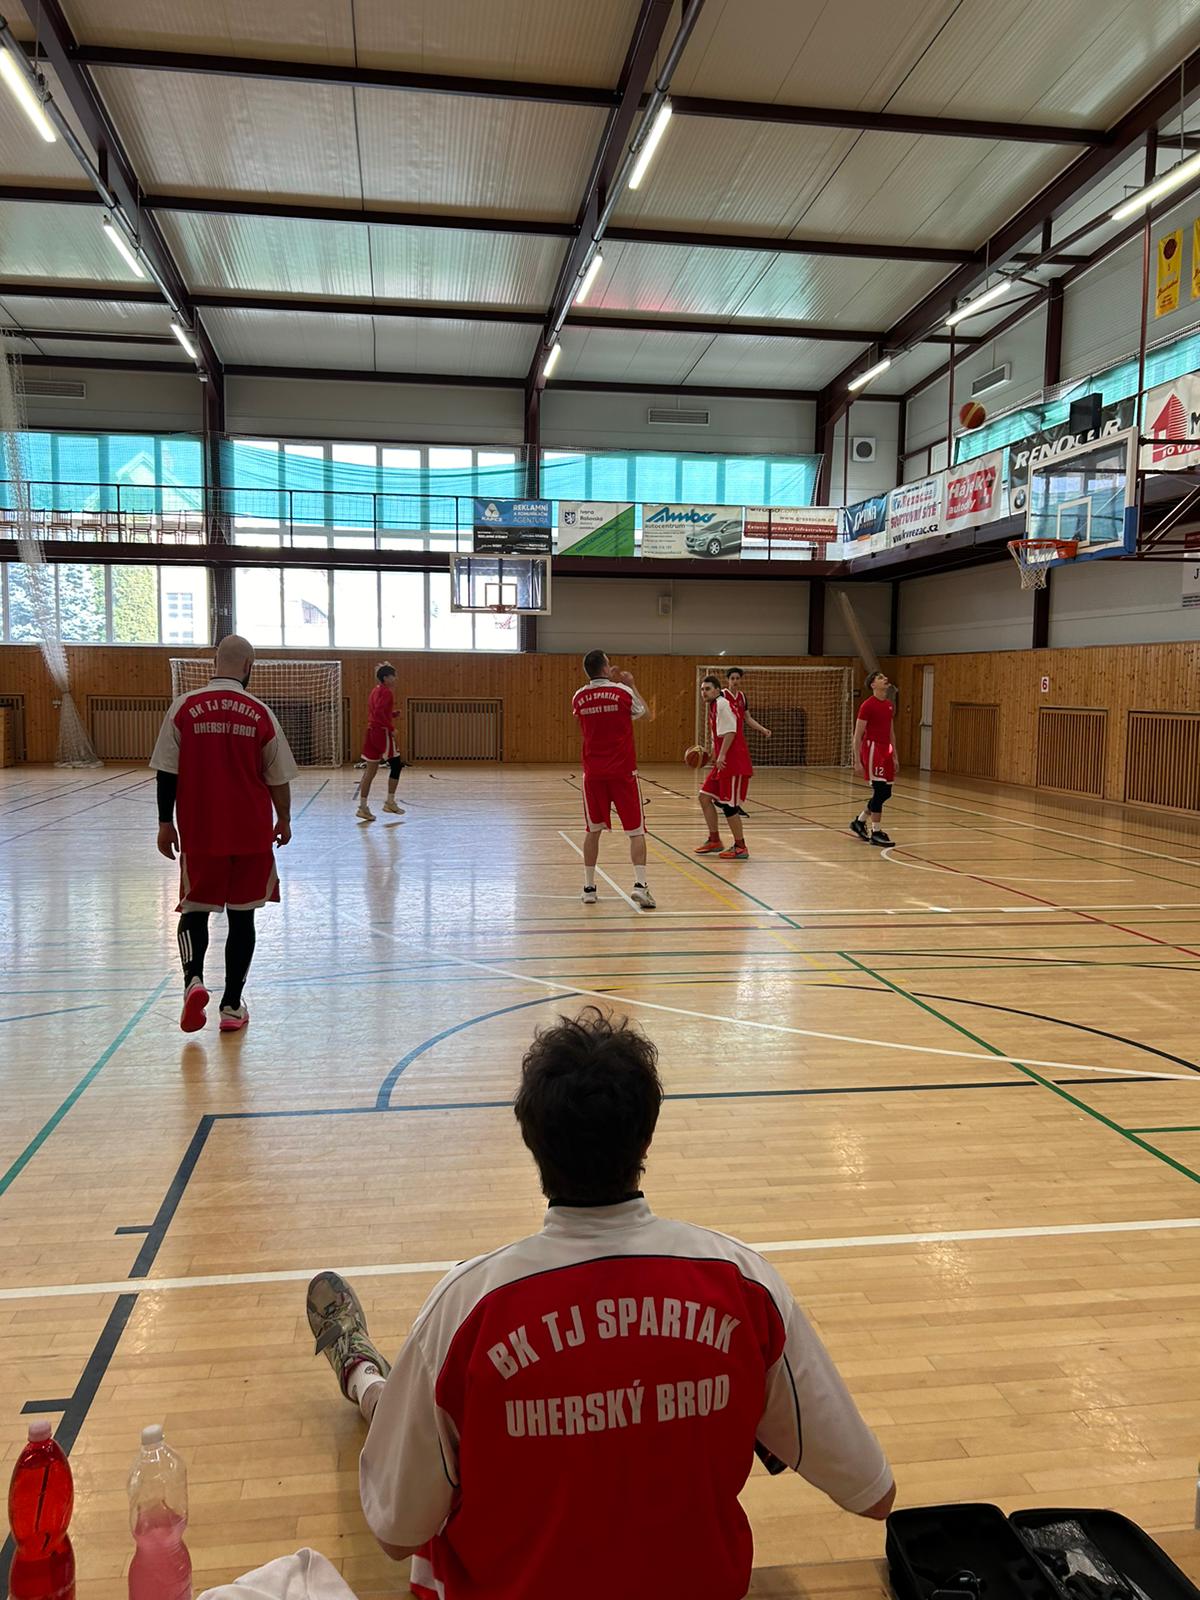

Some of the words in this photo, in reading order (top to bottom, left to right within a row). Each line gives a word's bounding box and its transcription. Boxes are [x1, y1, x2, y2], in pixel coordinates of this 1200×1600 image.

[512, 503, 548, 511] REKLAMNÍ
[1042, 678, 1048, 690] 6
[593, 692, 620, 701] SPARTAK
[188, 703, 204, 718] BK
[205, 700, 218, 711] TJ
[221, 699, 261, 722] SPARTAK
[875, 766, 884, 776] 12
[487, 1325, 540, 1380] BK
[541, 1305, 586, 1352] TJ
[596, 1297, 741, 1354] SPARTAK
[505, 1379, 645, 1437] UHERSKÝ
[656, 1374, 730, 1422] BROD
